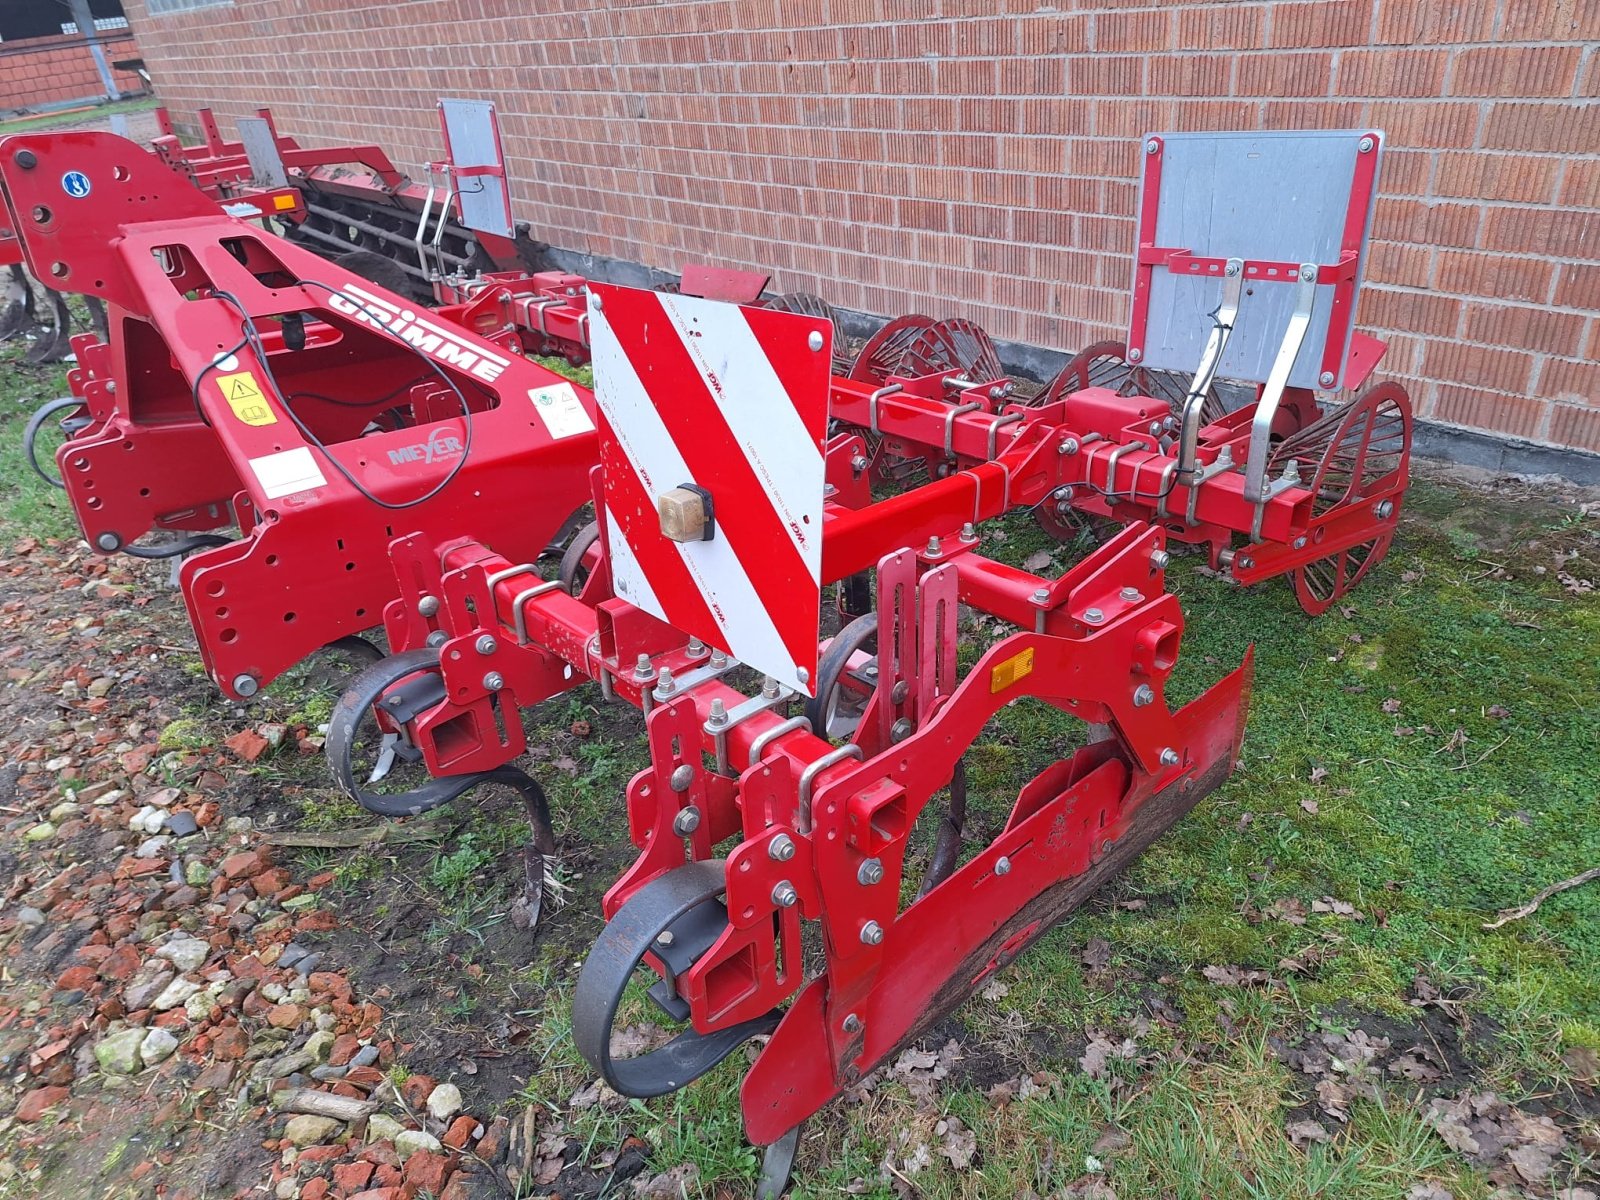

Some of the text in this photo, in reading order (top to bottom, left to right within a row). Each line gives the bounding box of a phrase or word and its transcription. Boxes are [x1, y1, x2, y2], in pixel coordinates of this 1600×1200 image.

[705, 370, 722, 394] WGF
[387, 428, 464, 465] MEYER
[637, 467, 653, 487] WGF
[782, 508, 793, 521] DIN
[788, 520, 806, 544] WGF
[710, 601, 726, 623] WGF
